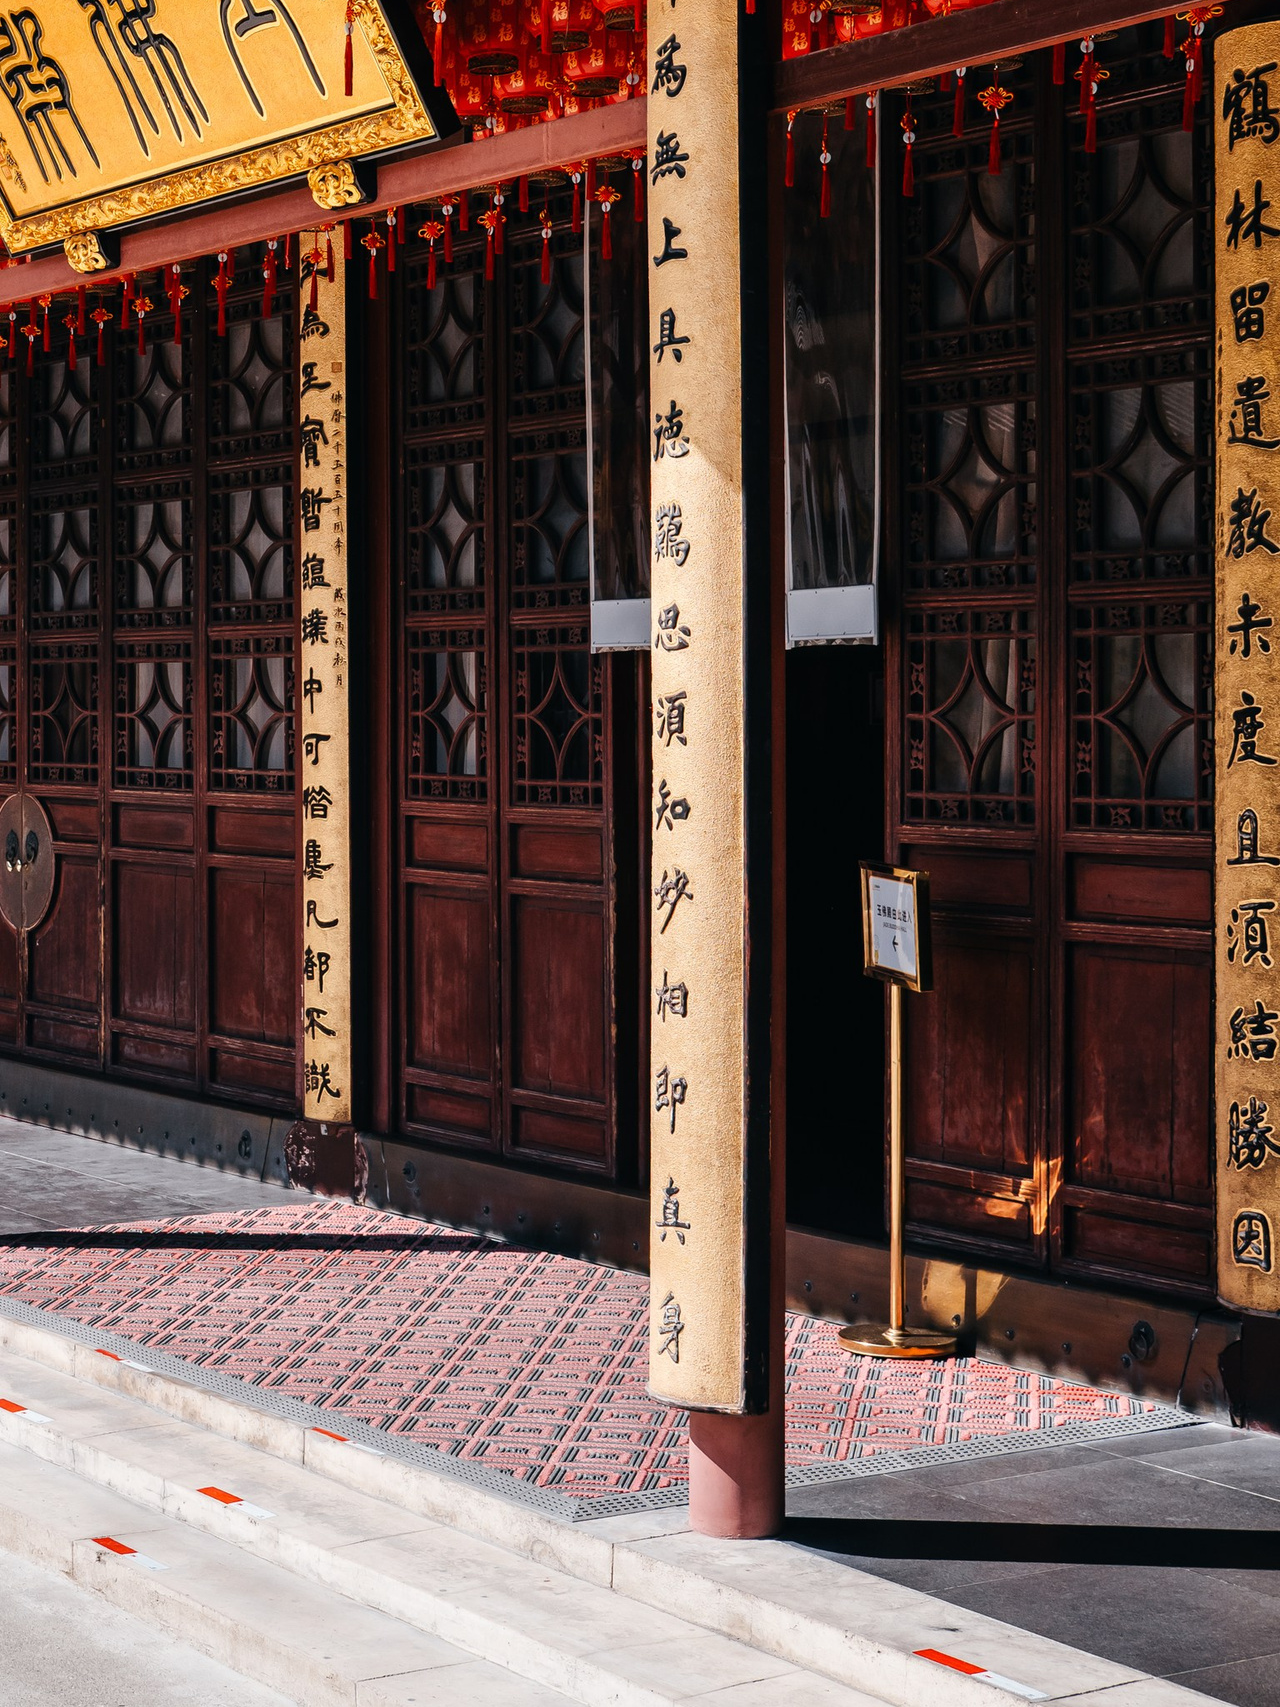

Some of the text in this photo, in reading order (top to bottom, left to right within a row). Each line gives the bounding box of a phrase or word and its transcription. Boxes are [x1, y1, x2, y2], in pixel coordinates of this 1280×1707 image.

[552, 2, 568, 21] 福
[498, 24, 513, 42] 福
[784, 18, 796, 32] 福
[792, 32, 808, 51] 福
[589, 49, 603, 67] 福
[509, 71, 524, 88] 福
[467, 87, 480, 104] 福
[564, 97, 578, 114] 福
